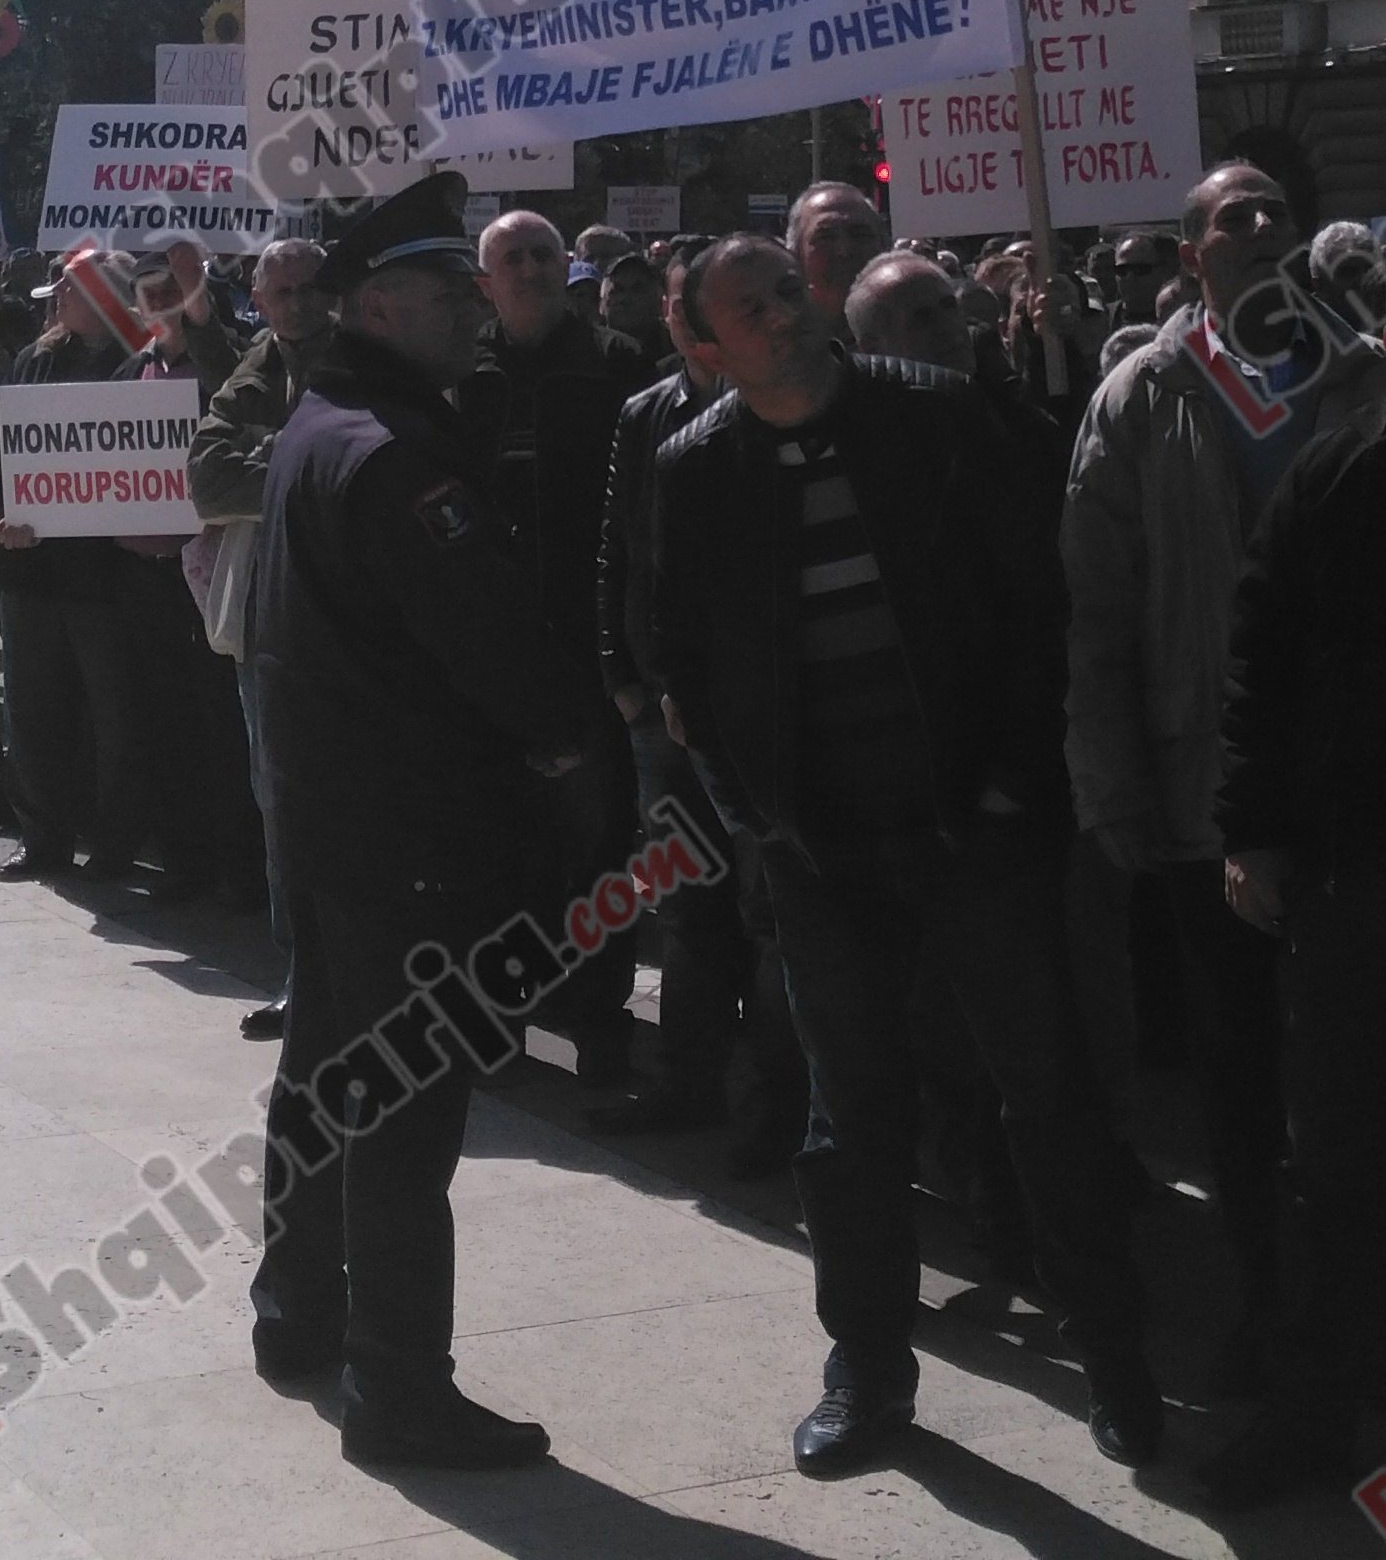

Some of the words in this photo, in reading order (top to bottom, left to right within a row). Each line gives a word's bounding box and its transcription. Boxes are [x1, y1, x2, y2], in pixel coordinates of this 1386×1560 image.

[266, 69, 391, 113] GJUETI
[436, 76, 489, 121] DHE
[496, 64, 623, 112] MBAJE
[899, 97, 931, 140] TE
[946, 88, 1086, 138] RREGLLT
[1099, 85, 1137, 126] ME
[88, 121, 248, 151] SHKODRA
[93, 159, 234, 193] KUNDËR
[919, 151, 998, 197] LIGJE
[1063, 141, 1171, 186] FORTA.
[44, 204, 275, 233] MONATORIUMIT
